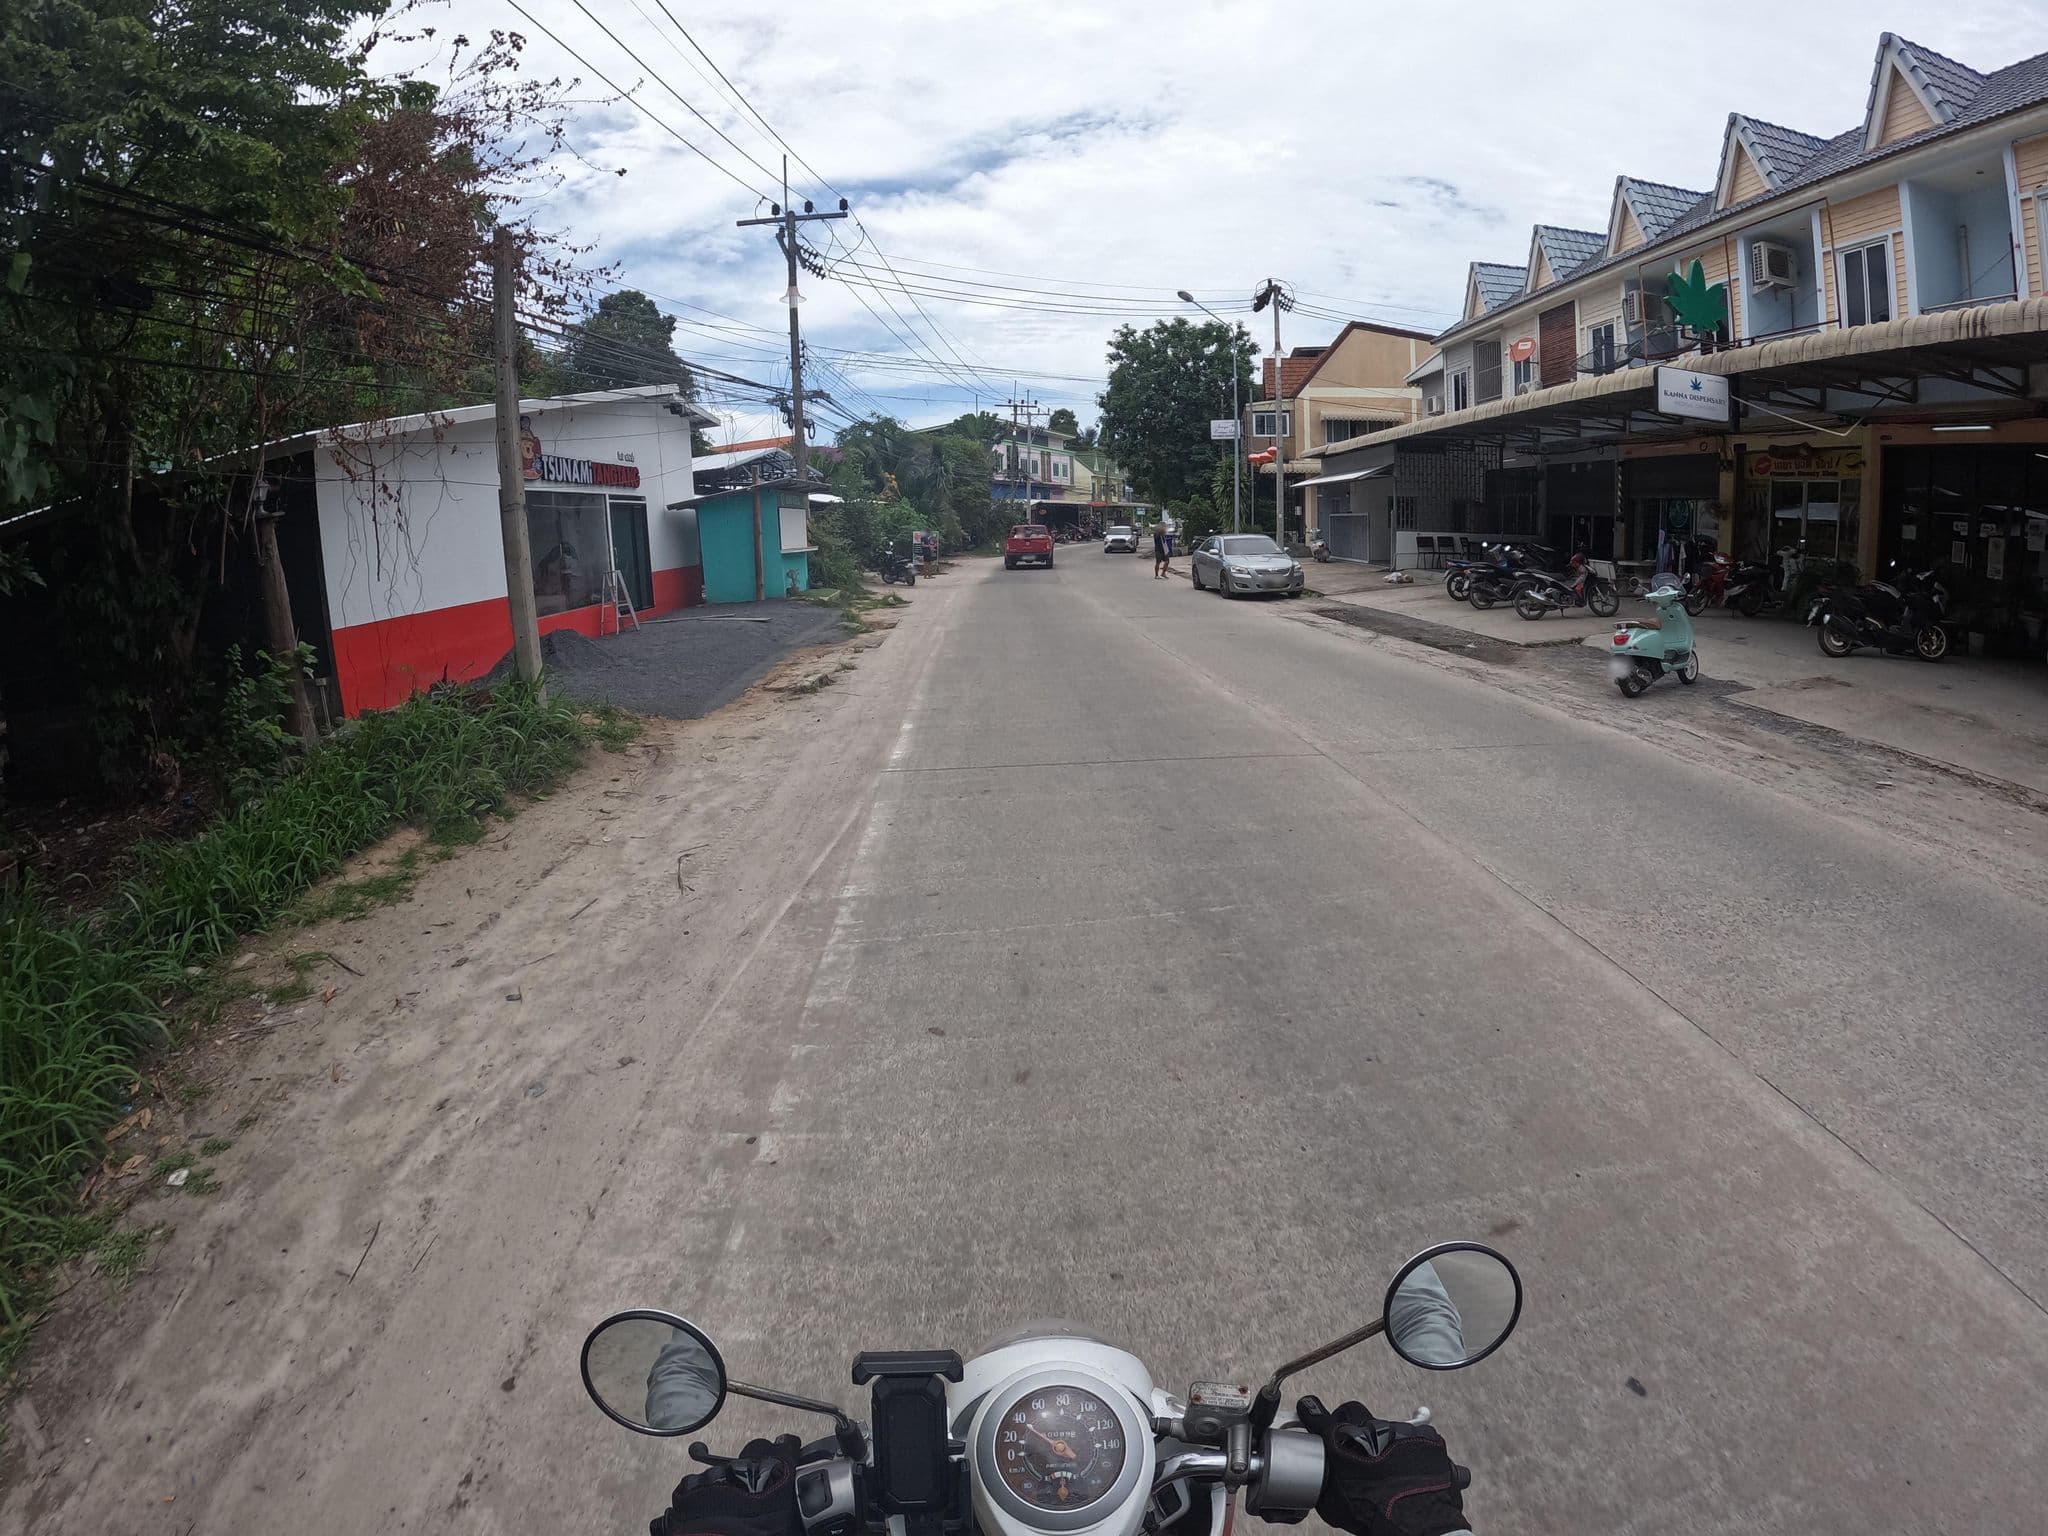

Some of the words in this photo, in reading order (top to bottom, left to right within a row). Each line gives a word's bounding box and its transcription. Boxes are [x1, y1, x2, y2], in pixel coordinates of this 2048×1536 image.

[1664, 389, 1688, 400] KANNA
[1689, 394, 1727, 405] DISPENSARY
[1031, 1398, 1046, 1410] 60
[1056, 1394, 1070, 1406] 80
[1080, 1400, 1097, 1412] 100
[1012, 1412, 1026, 1424] 40
[1096, 1418, 1114, 1430] 120
[1003, 1430, 1017, 1443] 20
[1102, 1438, 1120, 1450] 140
[1007, 1448, 1016, 1461] 0
